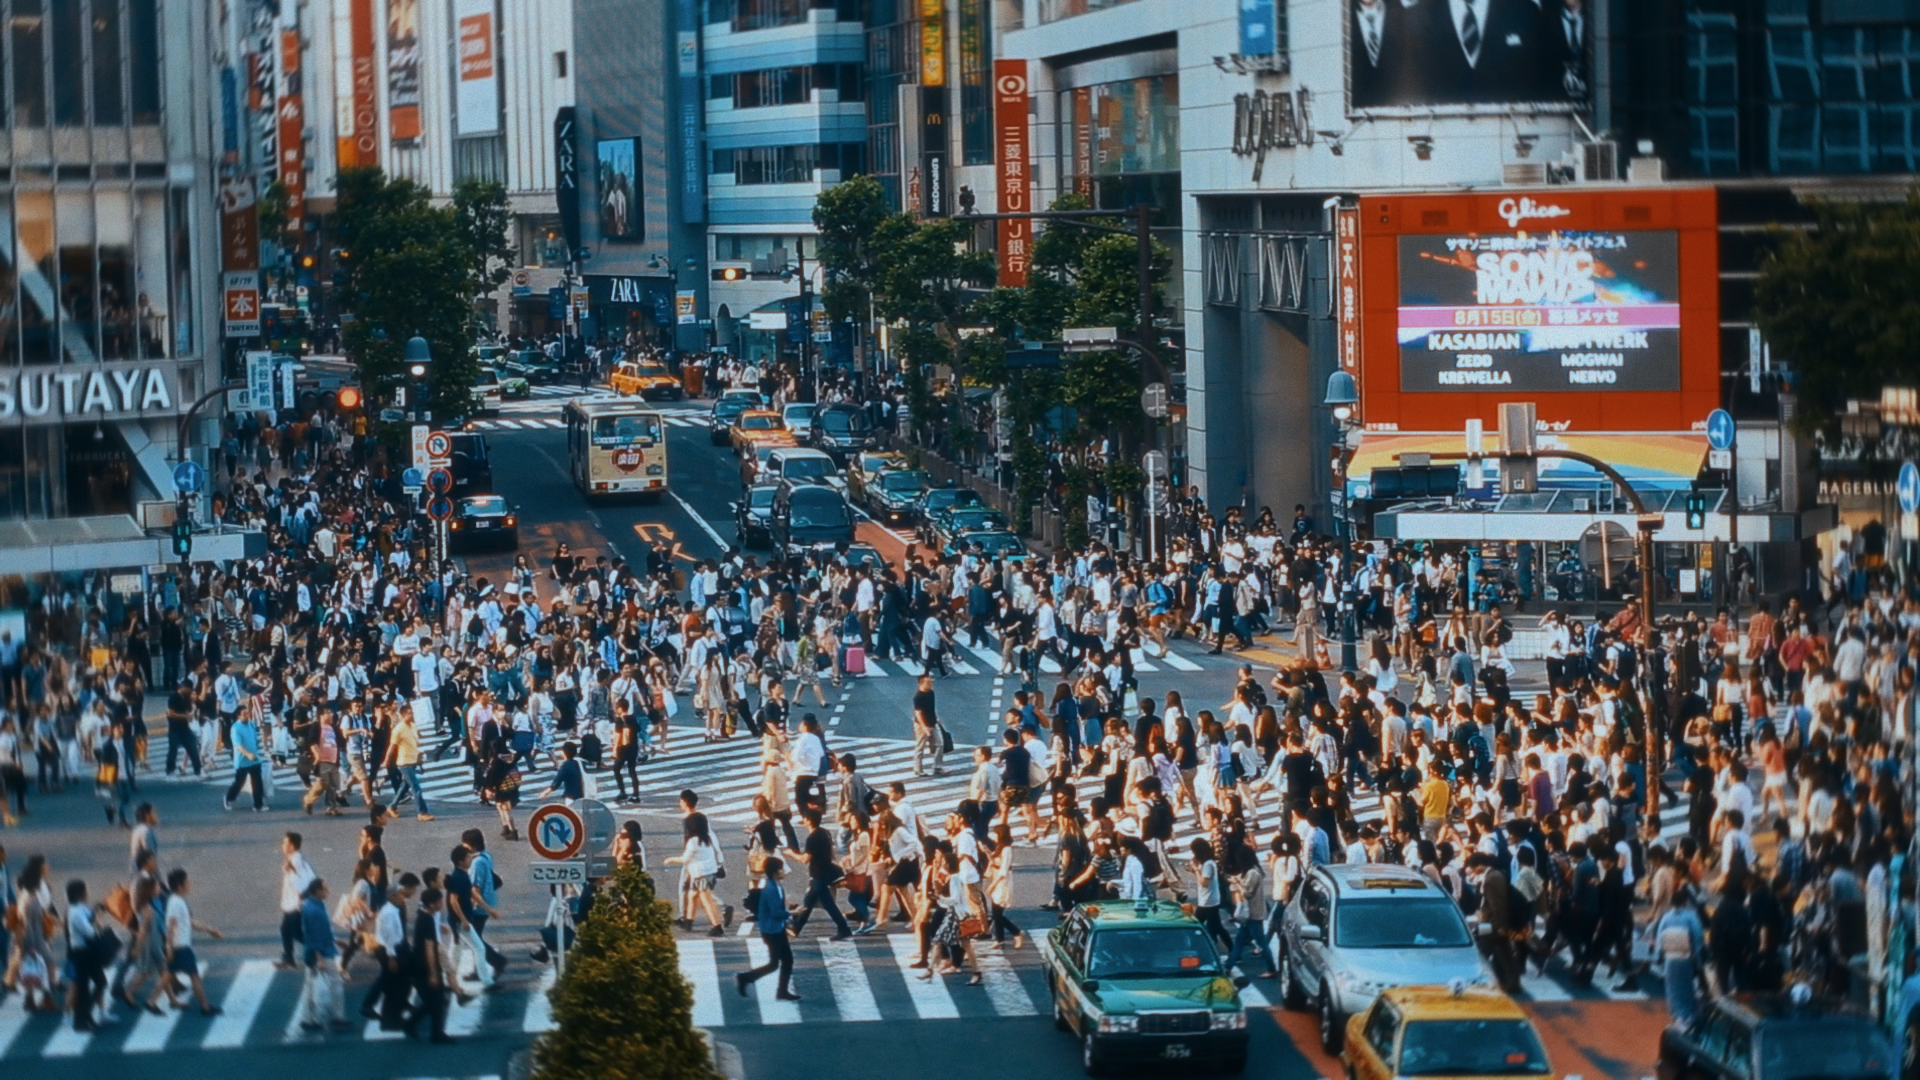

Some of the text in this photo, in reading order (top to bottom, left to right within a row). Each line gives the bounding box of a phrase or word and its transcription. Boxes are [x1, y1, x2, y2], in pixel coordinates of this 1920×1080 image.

[558, 120, 576, 190] ZARA
[1499, 196, 1571, 229] Glico
[1476, 251, 1594, 279] SONIC
[610, 278, 640, 302] ZARA
[231, 292, 253, 317] 本
[227, 324, 260, 332] TSUTAYA
[1428, 333, 1520, 351] KASABIAN
[1560, 353, 1624, 367] MOGWAI
[1438, 370, 1512, 385] KREWELLA
[1569, 369, 1617, 384] NERVO
[0, 368, 171, 418] SUTAYA
[1819, 480, 1900, 496] RAGEBLU
[532, 868, 581, 881] ここから
